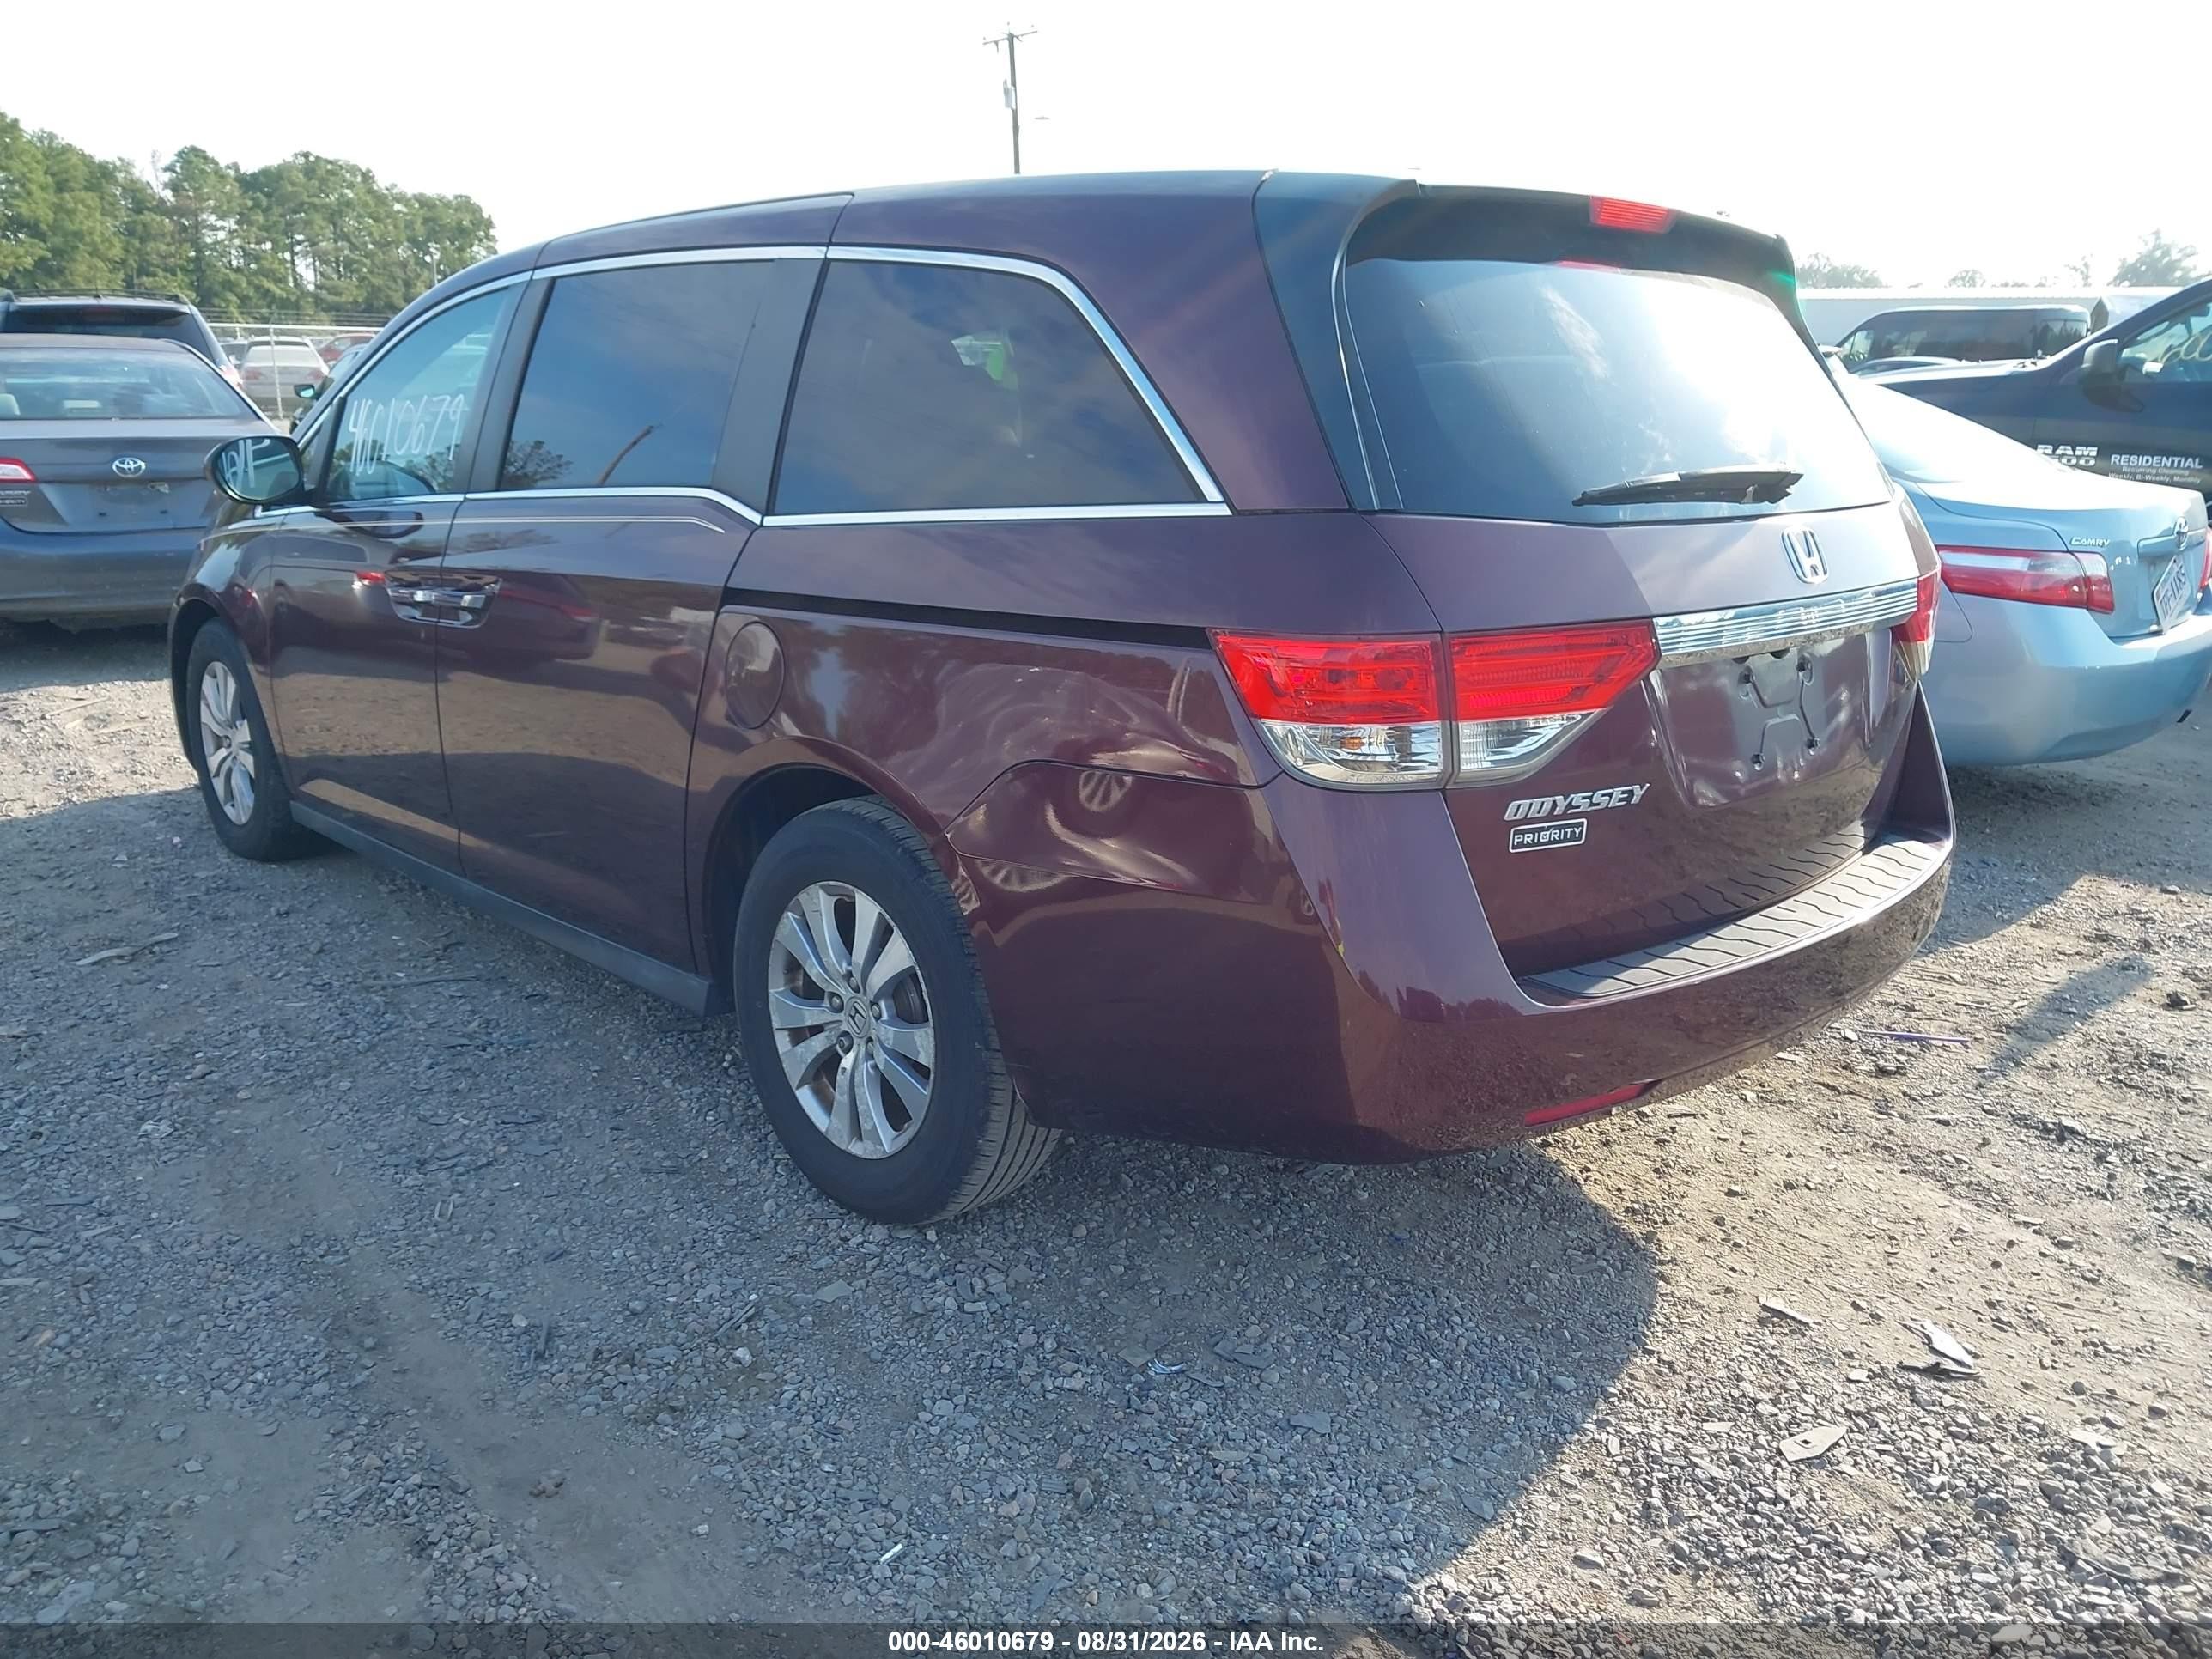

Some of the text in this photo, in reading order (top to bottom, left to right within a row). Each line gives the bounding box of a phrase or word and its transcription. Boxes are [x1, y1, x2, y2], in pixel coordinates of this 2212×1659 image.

[349, 393, 470, 477] 46010679
[2037, 444, 2099, 457] RAM
[2111, 454, 2203, 469] RESIDENTIAL
[2070, 537, 2110, 547] CAMRY
[1504, 783, 1650, 821] ODYSSEY
[1514, 827, 1582, 846] PRIORITY
